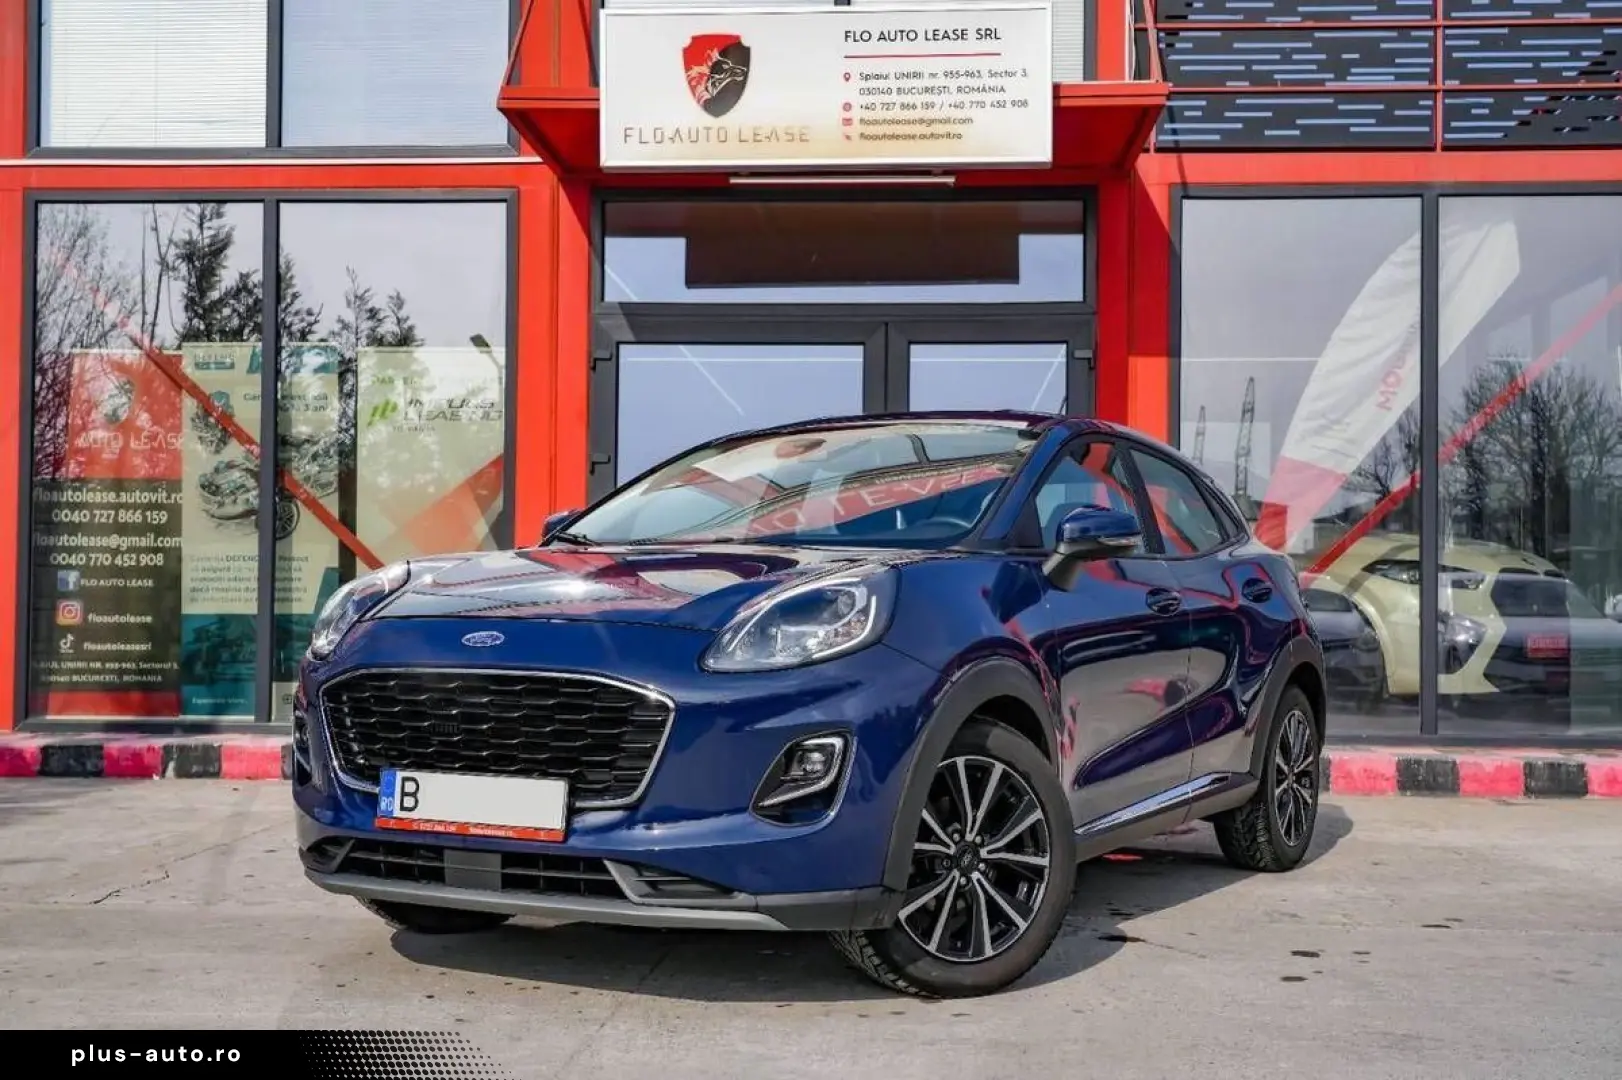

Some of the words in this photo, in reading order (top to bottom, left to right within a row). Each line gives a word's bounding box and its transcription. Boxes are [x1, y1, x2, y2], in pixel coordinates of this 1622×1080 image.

[844, 29, 872, 43] FLO
[877, 29, 918, 42] AUTO
[924, 28, 969, 41] LEASE
[975, 27, 1002, 40] SRL
[859, 71, 890, 82] Splaiul
[894, 71, 924, 80] UNIRII
[987, 69, 1017, 79] Sector
[859, 87, 893, 96] 030140
[956, 84, 1006, 95] ROMÂNIA
[880, 102, 896, 111] 727
[900, 102, 917, 111] 866
[920, 101, 935, 110] 159
[969, 100, 986, 109] 770
[990, 100, 1007, 109] 452
[859, 116, 974, 127] floautolease@gmail.com
[737, 125, 811, 143] LEASE
[859, 131, 963, 142] floautolease.autovit.ro
[52, 509, 90, 523] 0040
[93, 510, 115, 523] 727
[118, 510, 143, 523] 866
[145, 510, 168, 524] 159
[50, 553, 86, 567] 0040
[89, 553, 112, 567] 770
[114, 553, 136, 566] 452
[139, 552, 164, 567] 908
[80, 578, 98, 587] FLO
[99, 578, 125, 587] AUTO
[127, 578, 154, 587] LEASE
[88, 613, 153, 624] floautolease
[399, 776, 420, 812] B
